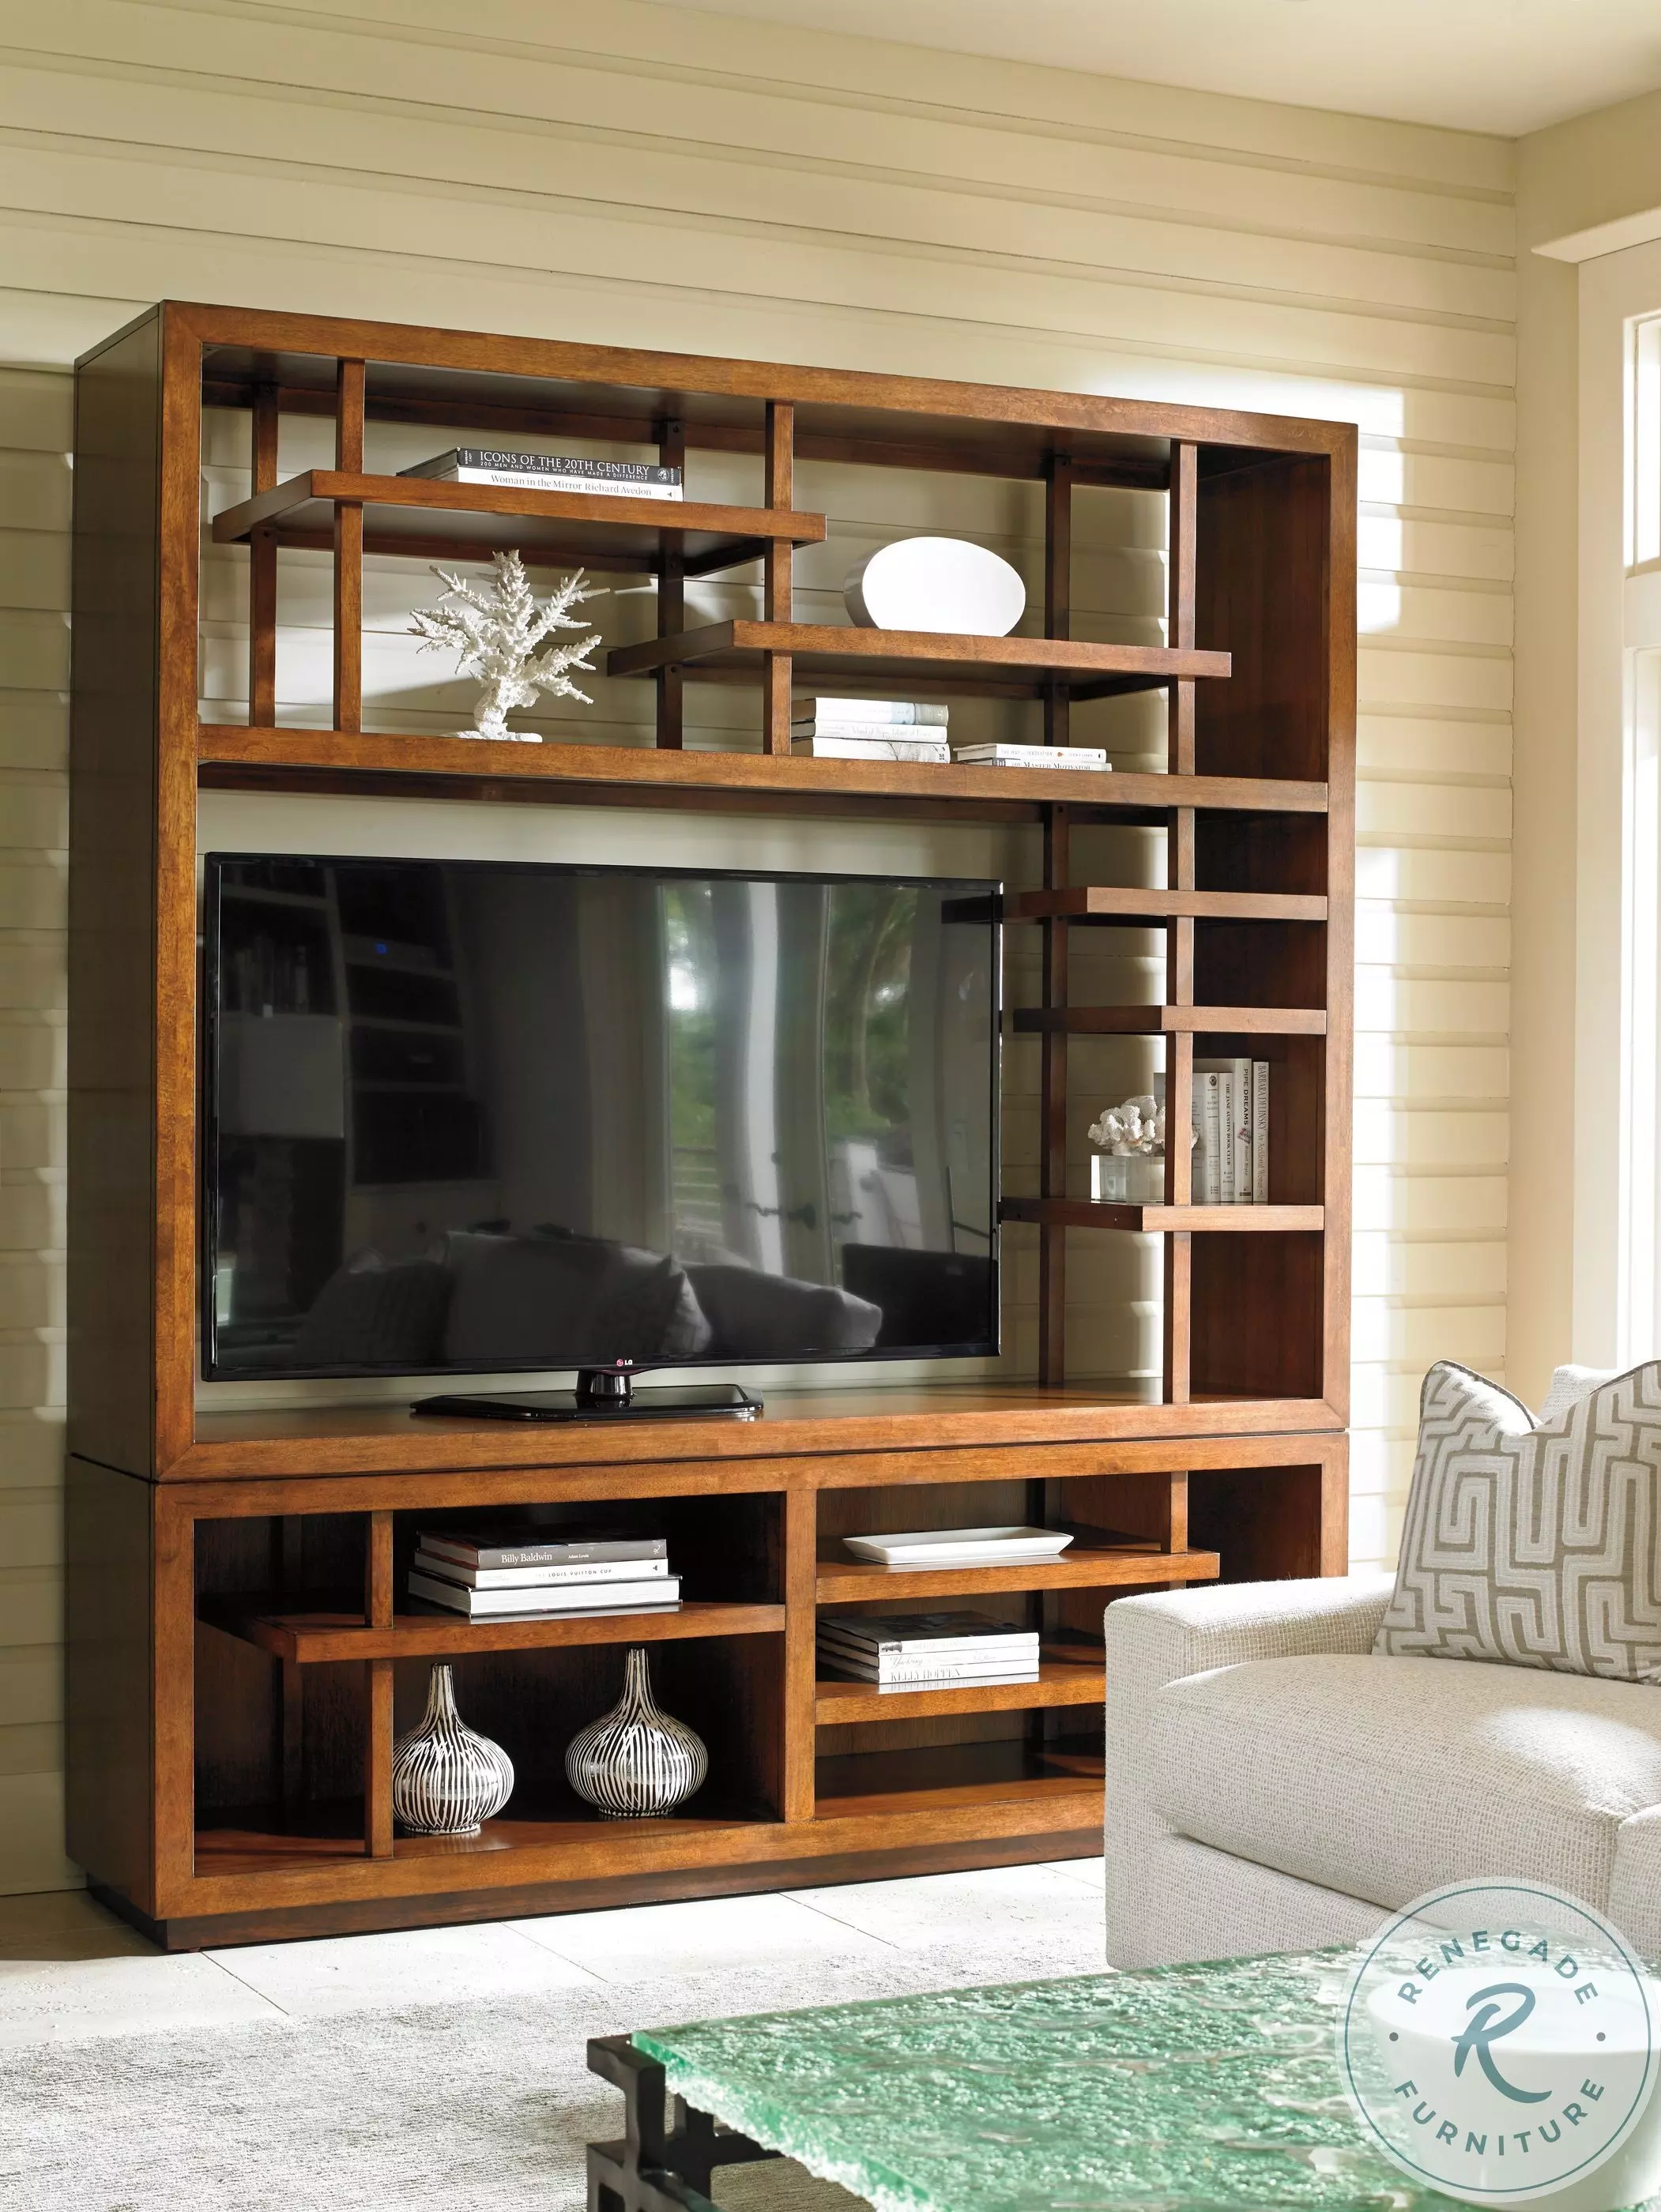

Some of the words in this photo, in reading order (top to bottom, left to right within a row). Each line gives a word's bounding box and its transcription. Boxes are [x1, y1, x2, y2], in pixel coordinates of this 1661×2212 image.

[480, 451, 517, 465] ICONS
[520, 454, 535, 465] OF
[537, 457, 562, 468] THE
[564, 458, 593, 471] 20TH
[597, 461, 650, 476] CENTURY
[491, 474, 525, 485] Woman
[526, 477, 536, 486] in
[537, 478, 552, 487] the
[553, 480, 582, 490] Mirror
[585, 483, 619, 493] Richard
[620, 485, 651, 496] Avedon
[1258, 1066, 1267, 1096] BARBARA
[1258, 1096, 1267, 1130] DELINSKY
[501, 1555, 519, 1565] Billy
[520, 1552, 552, 1562] Baldwin
[891, 1671, 920, 1682] KELLY
